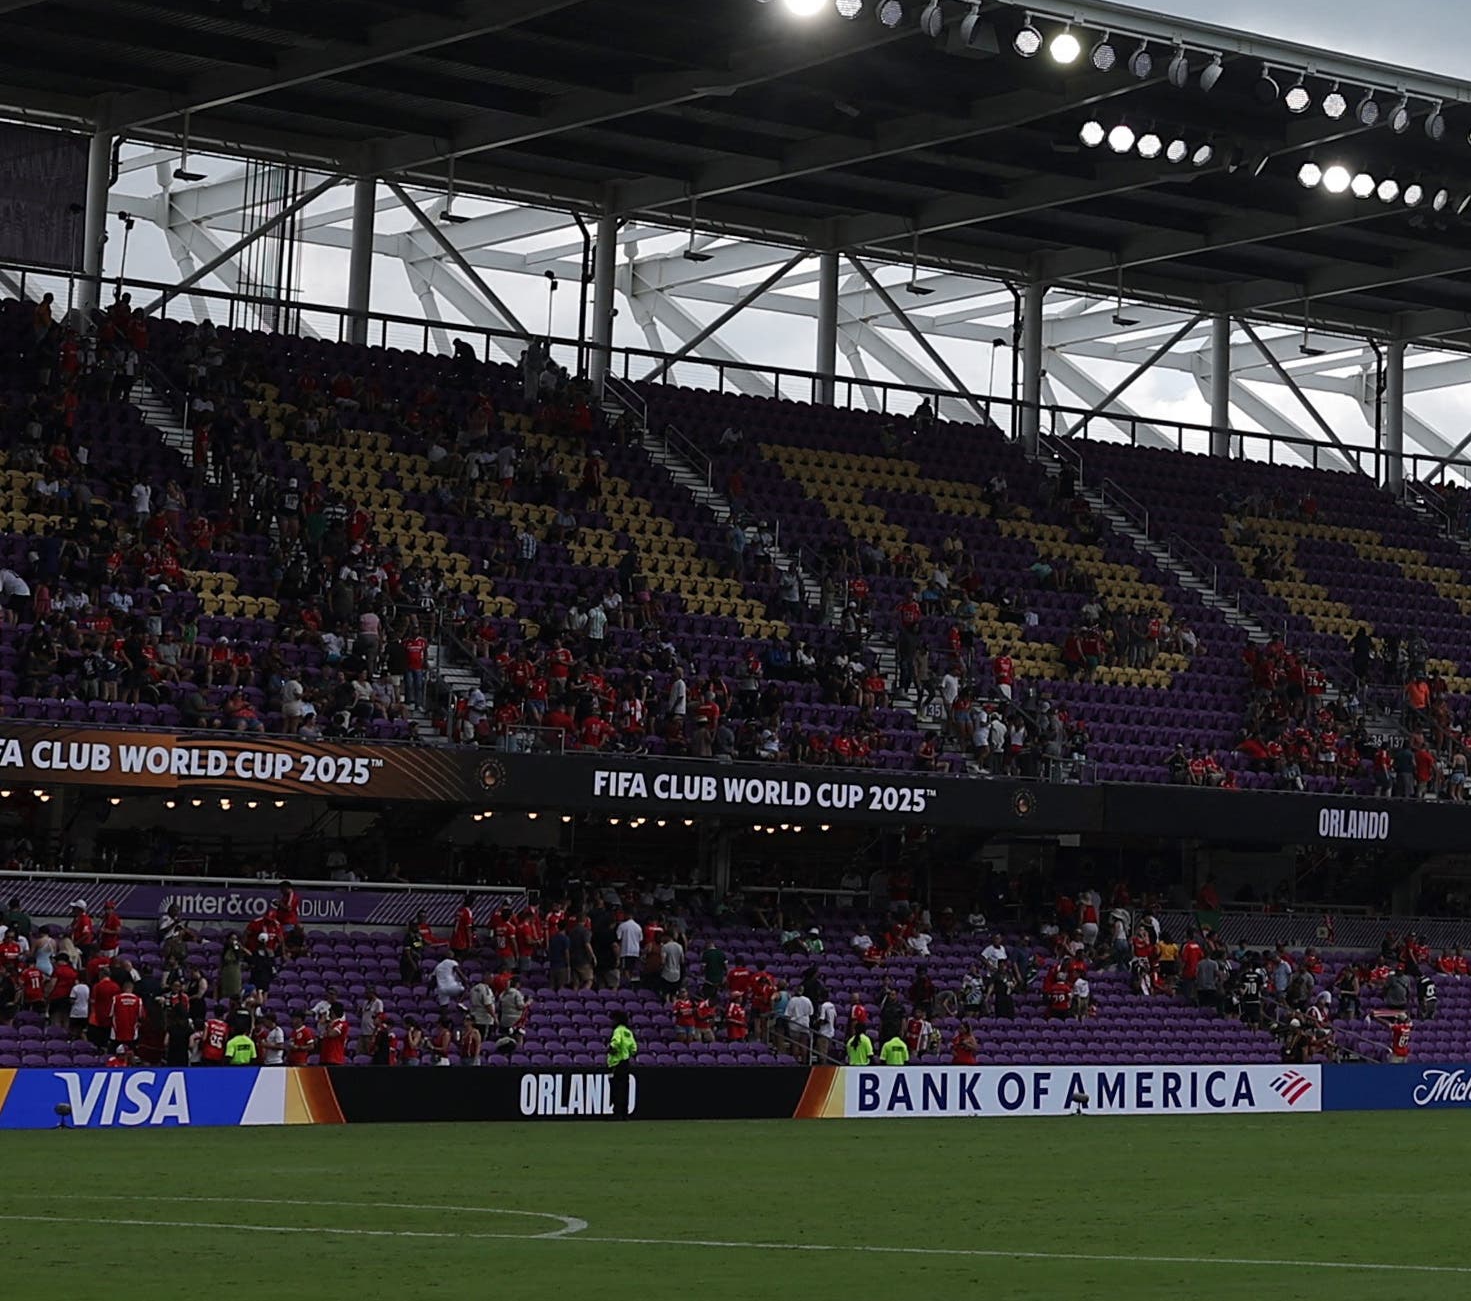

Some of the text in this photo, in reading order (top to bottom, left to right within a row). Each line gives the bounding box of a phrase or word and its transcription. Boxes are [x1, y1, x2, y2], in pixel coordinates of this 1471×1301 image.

[31, 739, 111, 773] CLUB
[118, 744, 228, 777] WORLD
[234, 751, 294, 780] CUP
[593, 770, 648, 798] FIFA
[653, 773, 718, 802] CLUB
[723, 777, 812, 807] WORLD
[816, 783, 864, 809] CUP
[1318, 807, 1390, 840] ORLANDO
[53, 1070, 191, 1126] VISA
[858, 1069, 1256, 1112] BANK OF AMERICA
